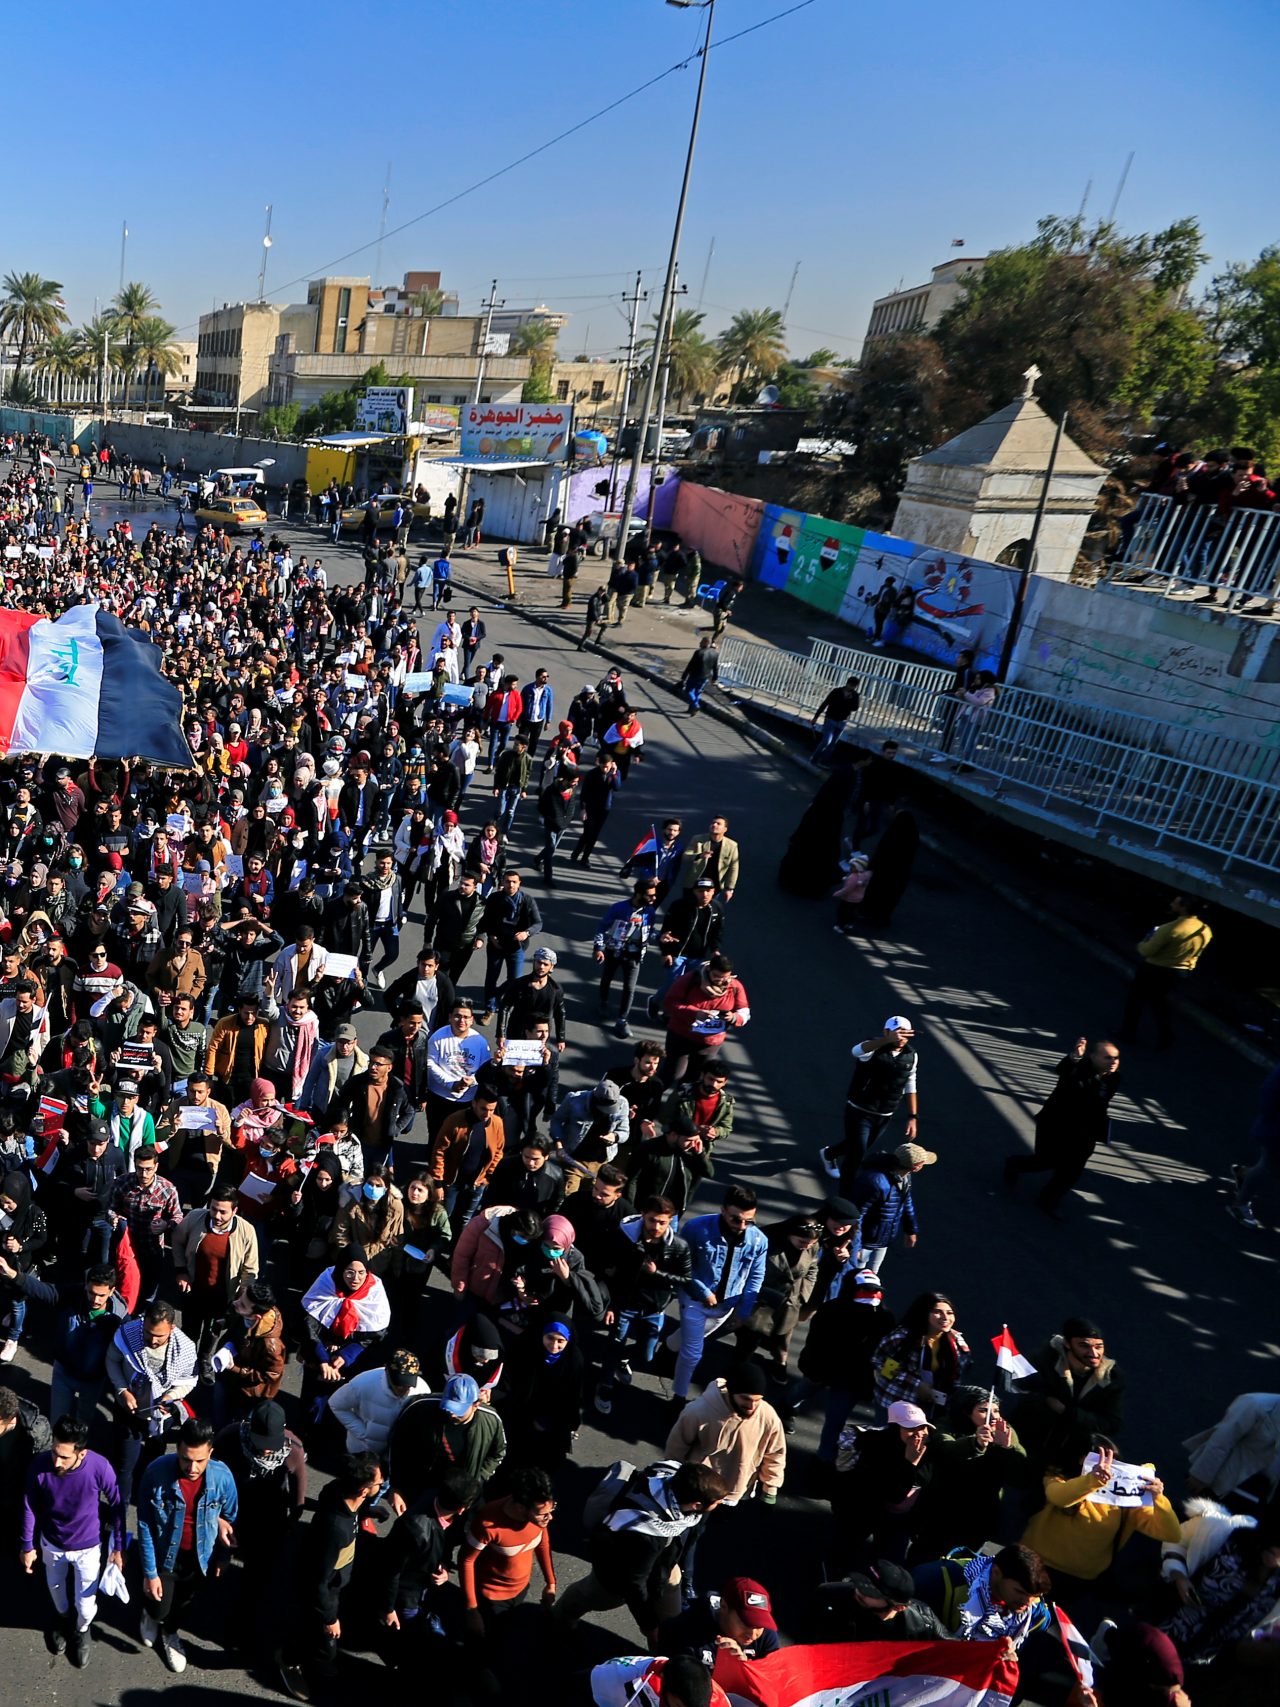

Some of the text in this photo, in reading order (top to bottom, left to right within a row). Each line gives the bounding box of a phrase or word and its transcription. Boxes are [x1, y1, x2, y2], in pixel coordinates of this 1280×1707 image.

[469, 407, 524, 426] الجوهرة
[525, 407, 563, 428] مخبز
[794, 555, 819, 583] 25
